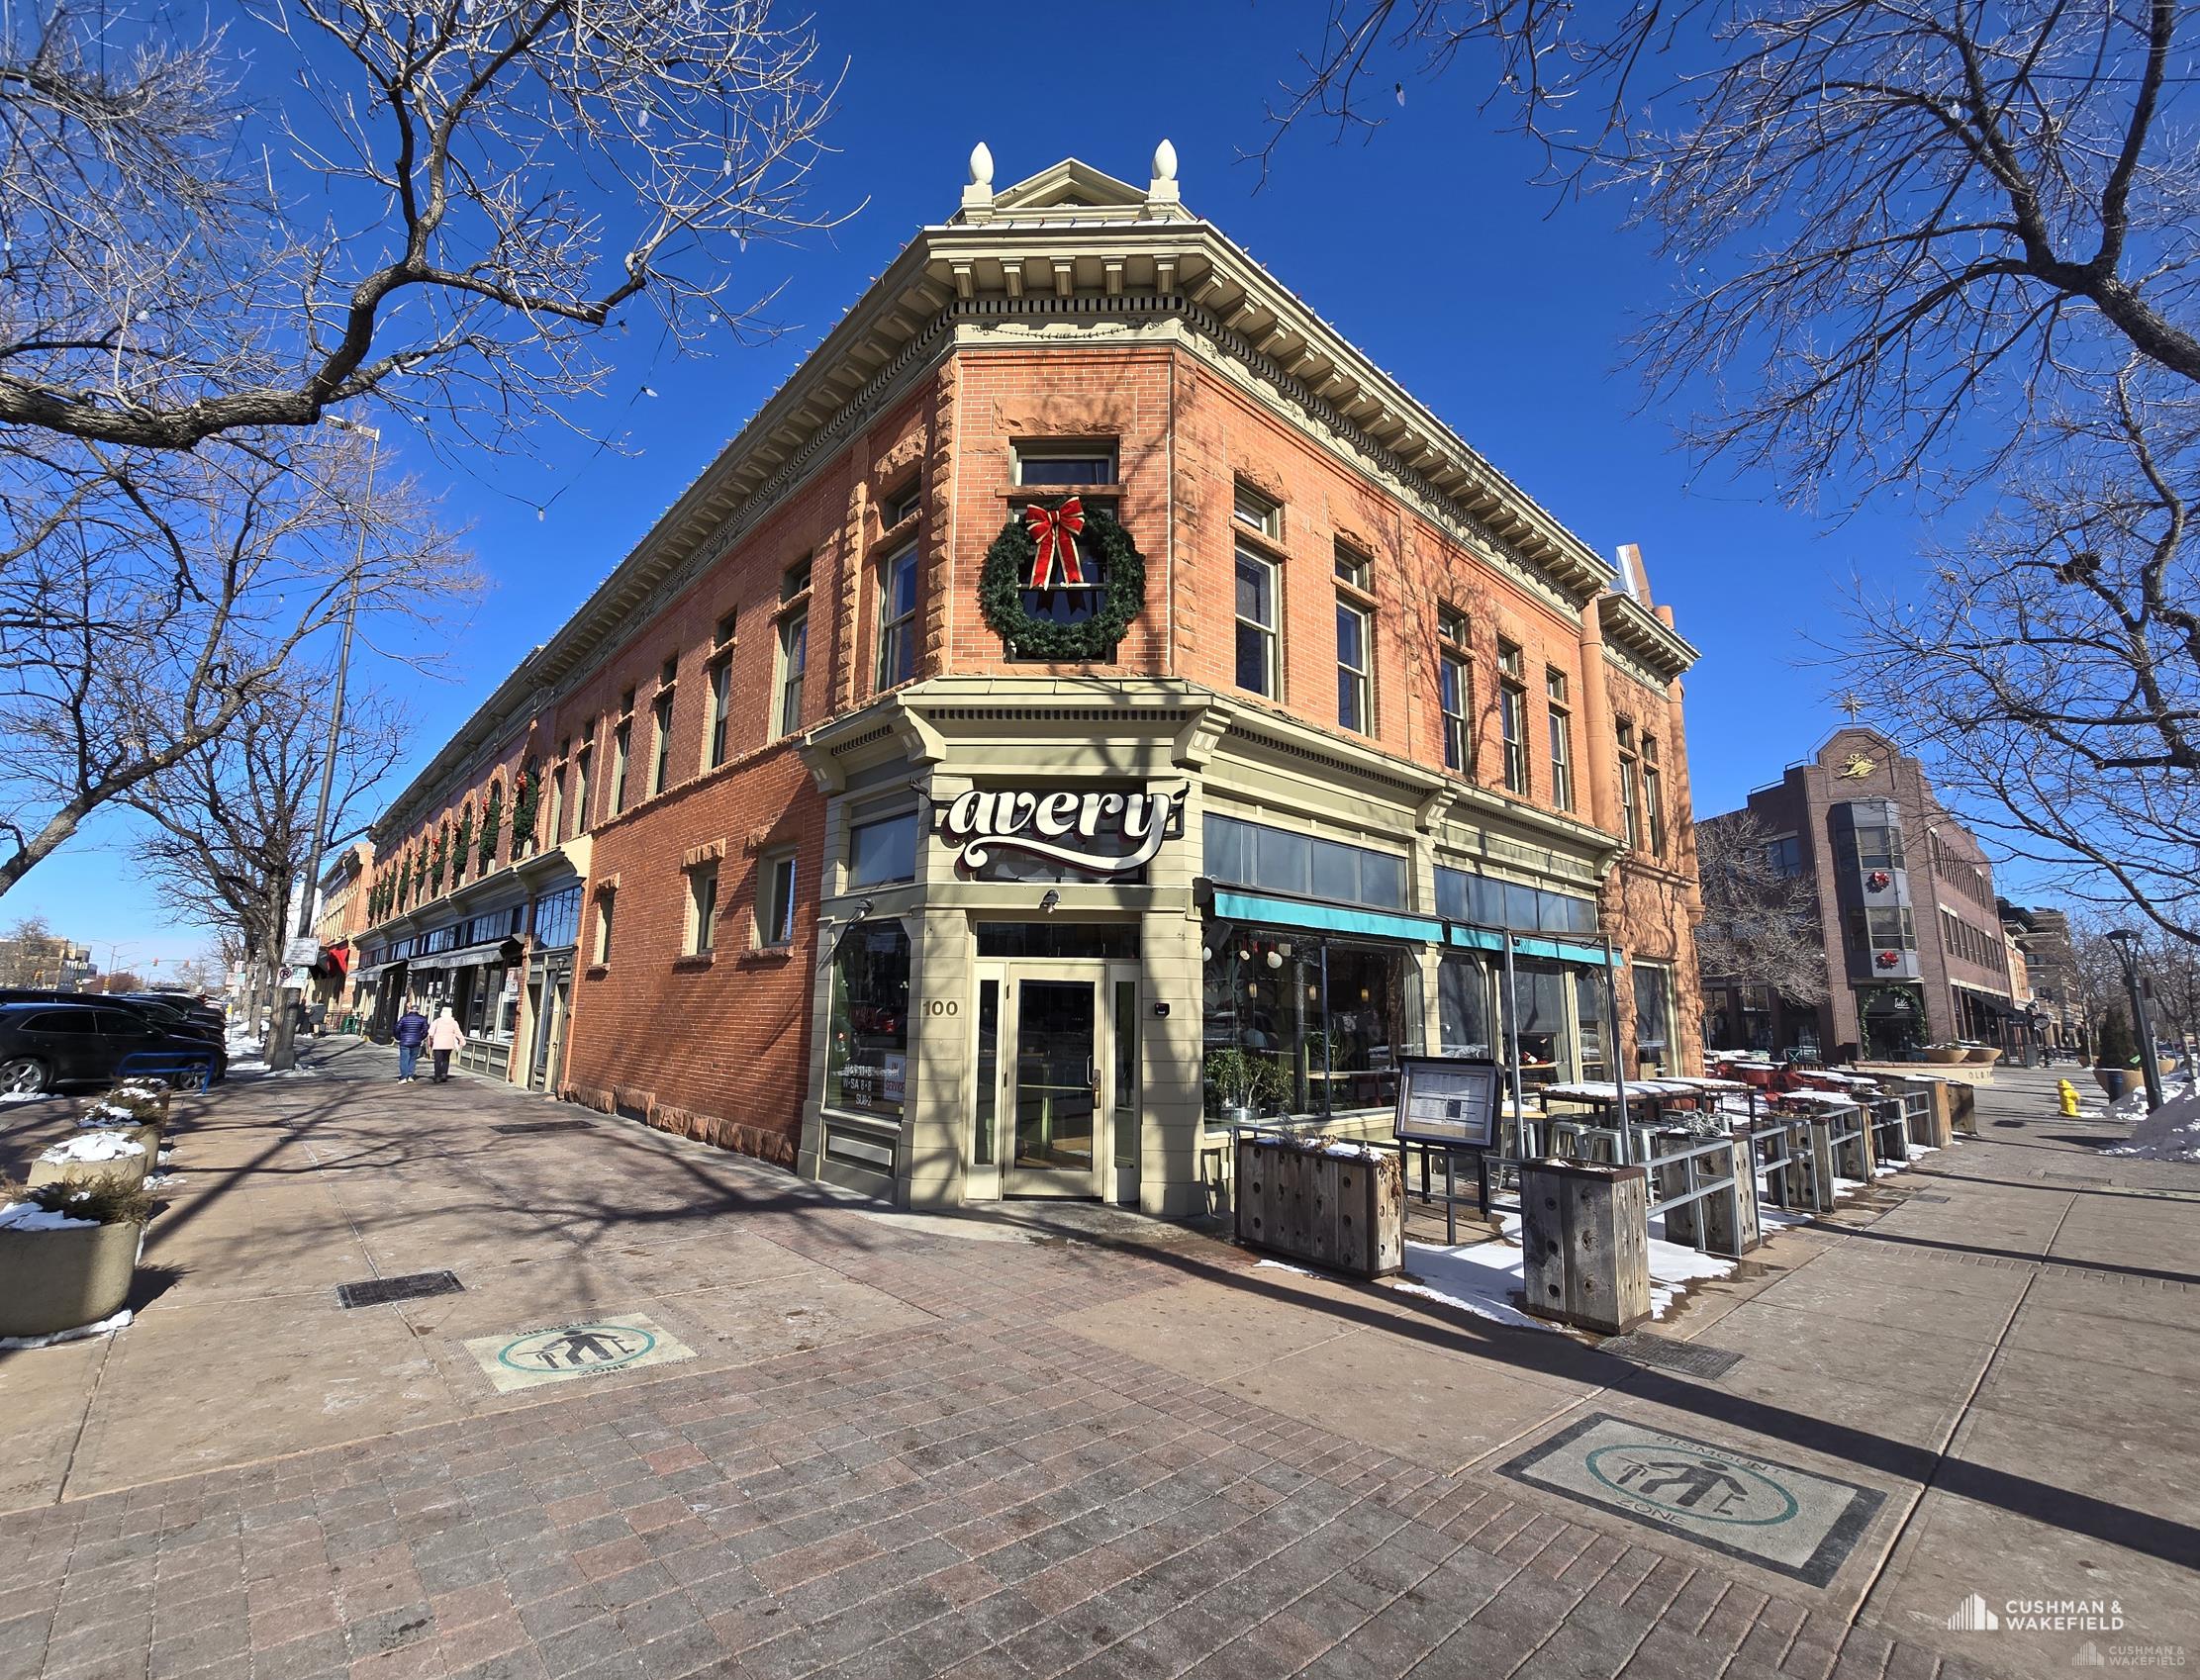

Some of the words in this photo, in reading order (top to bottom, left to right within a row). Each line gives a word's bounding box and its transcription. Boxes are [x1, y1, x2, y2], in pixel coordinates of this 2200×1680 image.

[948, 790, 1171, 871] avery
[922, 1000, 958, 1016] 100
[577, 1362, 631, 1376] ZONE
[1657, 1436, 1783, 1475] DISMOUNT
[1615, 1500, 1687, 1526] ZONE
